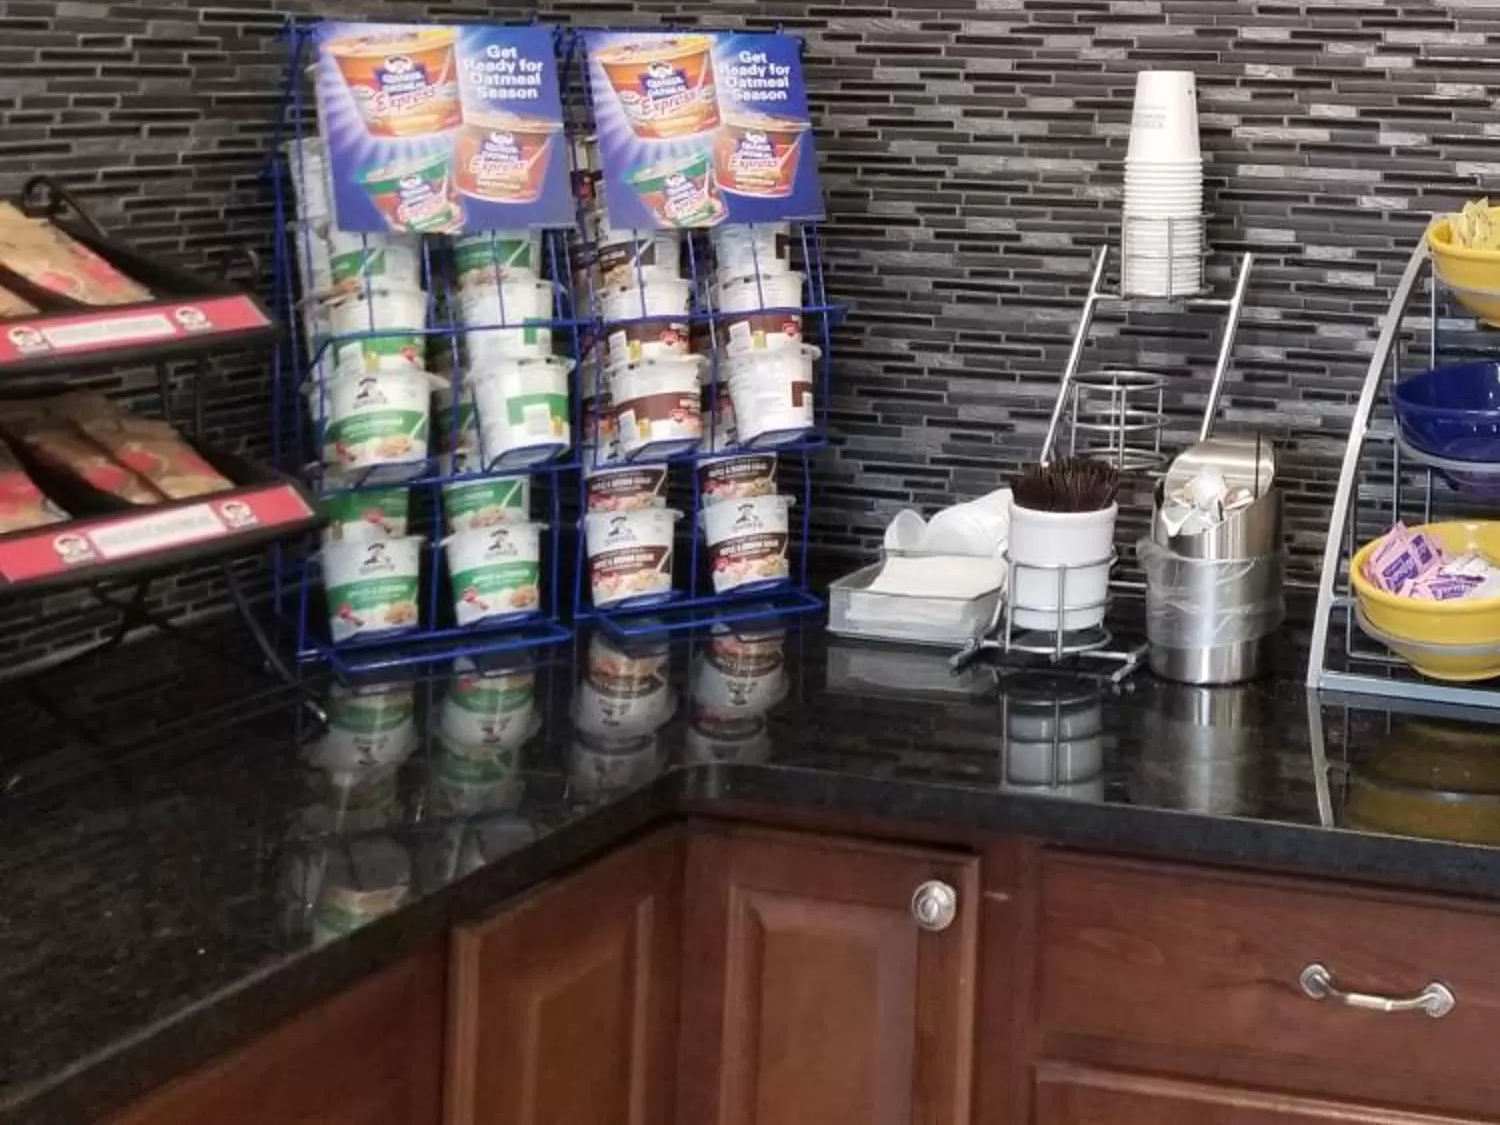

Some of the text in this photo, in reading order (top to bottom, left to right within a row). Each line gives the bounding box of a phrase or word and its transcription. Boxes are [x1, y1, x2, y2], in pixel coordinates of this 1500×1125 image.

[486, 44, 518, 59] Get
[739, 50, 768, 64] Get
[519, 57, 544, 73] for
[769, 62, 791, 76] for
[470, 72, 542, 86] Oatmeal
[725, 75, 790, 88] Oatmeal
[476, 86, 539, 100] Season
[731, 88, 788, 101] Season
